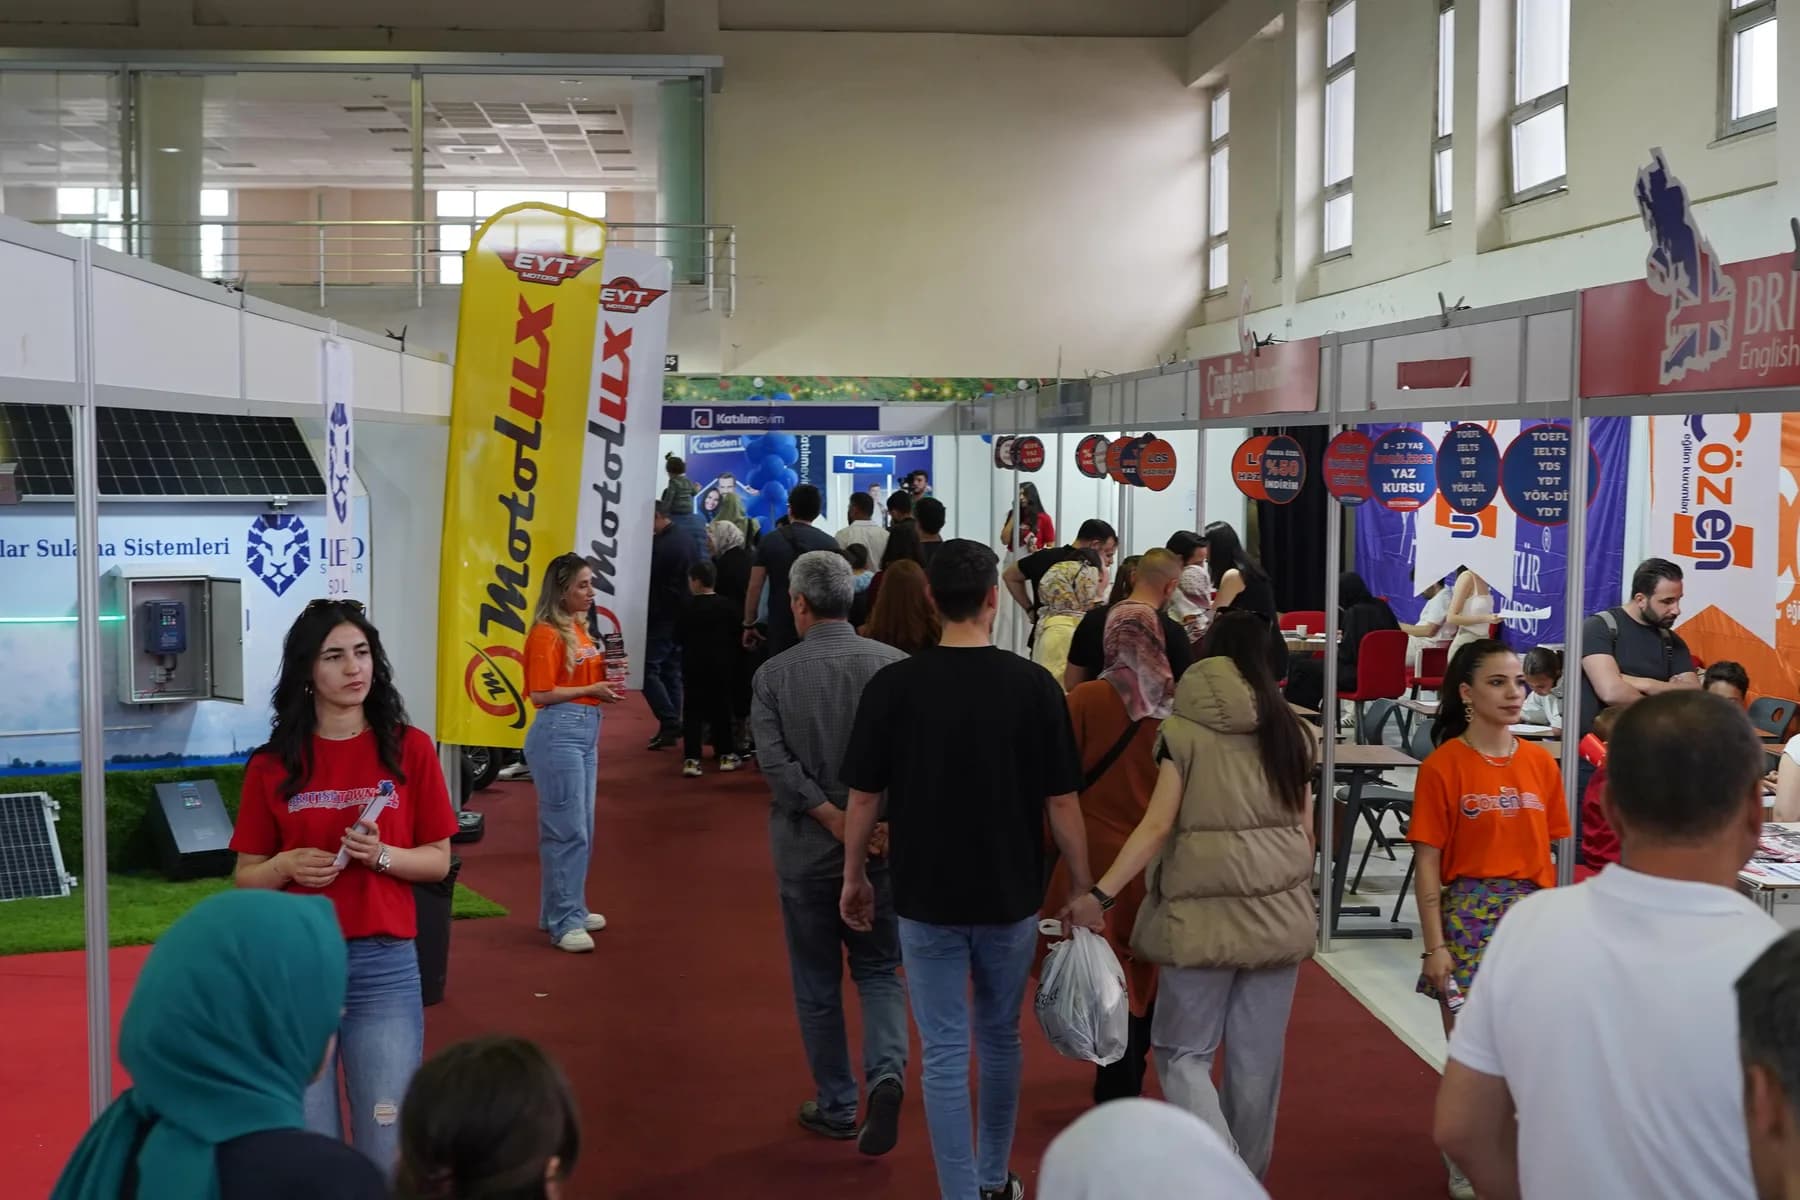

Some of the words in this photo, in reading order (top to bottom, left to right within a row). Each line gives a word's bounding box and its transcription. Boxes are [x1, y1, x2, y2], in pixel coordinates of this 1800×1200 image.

[513, 252, 574, 274] EYT
[521, 271, 560, 282] MOTORS
[600, 288, 648, 304] EYT
[1739, 334, 1800, 377] English
[1456, 430, 1480, 439] TOEFL
[1531, 432, 1569, 441] TOEFL
[1533, 447, 1567, 456] IELTS
[1538, 462, 1561, 471] YDS
[1391, 468, 1417, 479] YAZ
[1537, 477, 1562, 486] YDT
[1382, 482, 1425, 494] KURSU
[1523, 490, 1570, 501] YÖK-Dİ
[1536, 507, 1562, 517] YDT
[37, 539, 115, 557] Sulaa
[124, 537, 230, 556] Sistemleri
